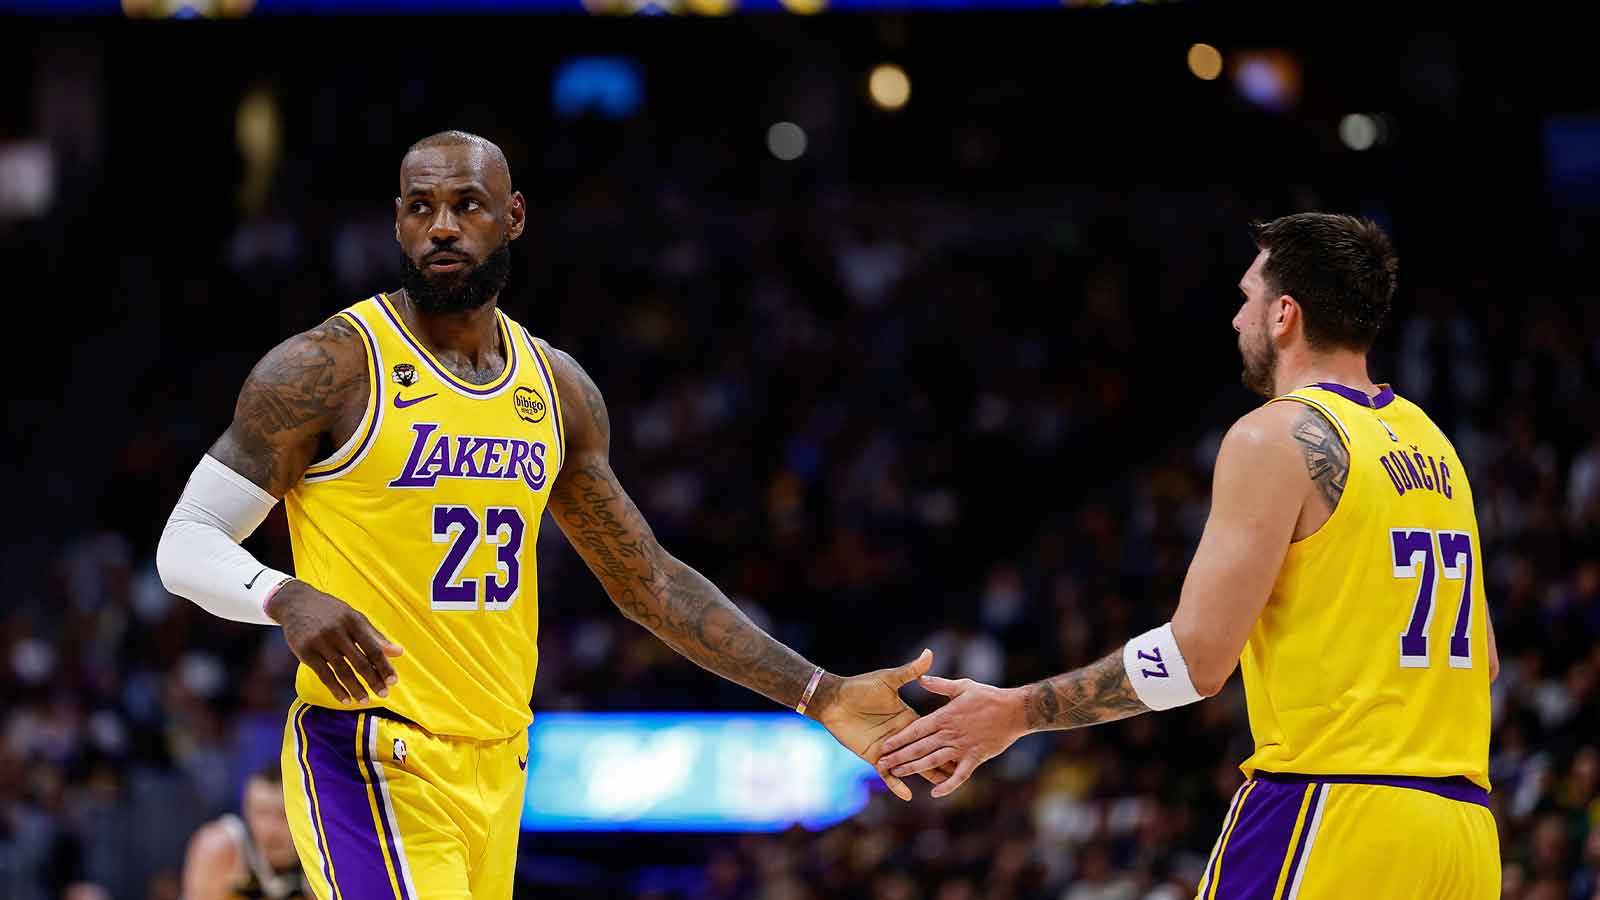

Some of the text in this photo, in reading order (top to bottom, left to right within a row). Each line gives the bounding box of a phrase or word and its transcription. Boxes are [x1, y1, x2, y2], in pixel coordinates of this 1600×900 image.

[516, 395, 543, 414] bibigo
[387, 423, 546, 491] LAKERS
[1380, 444, 1452, 500] DONČIĆ
[431, 504, 527, 611] 23
[1390, 528, 1473, 668] 77
[1137, 647, 1169, 679] 77
